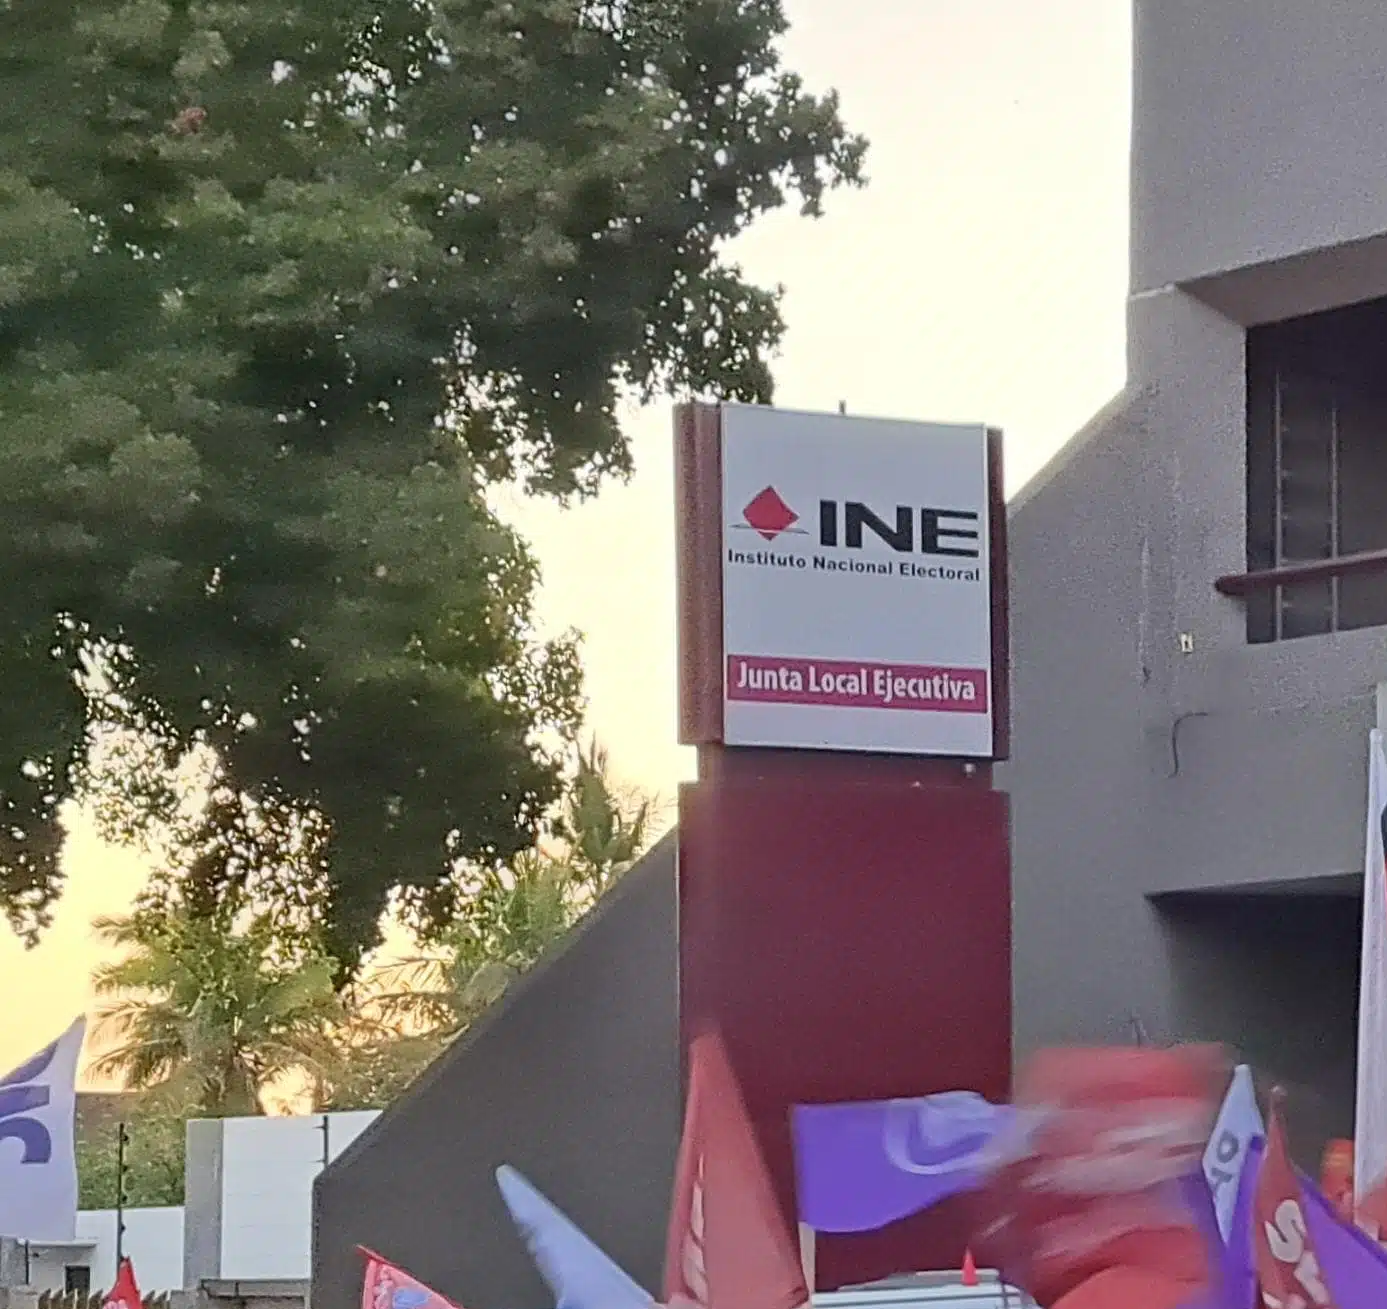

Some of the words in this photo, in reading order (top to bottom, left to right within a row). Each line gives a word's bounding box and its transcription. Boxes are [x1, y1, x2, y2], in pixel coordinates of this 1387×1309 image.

[819, 500, 979, 558] INE
[727, 548, 807, 569] Instituto
[813, 556, 893, 575] Nacional
[899, 562, 981, 582] Electoral
[737, 661, 802, 690] Junta
[809, 665, 868, 696] Local
[873, 670, 976, 702] Ejecutiva
